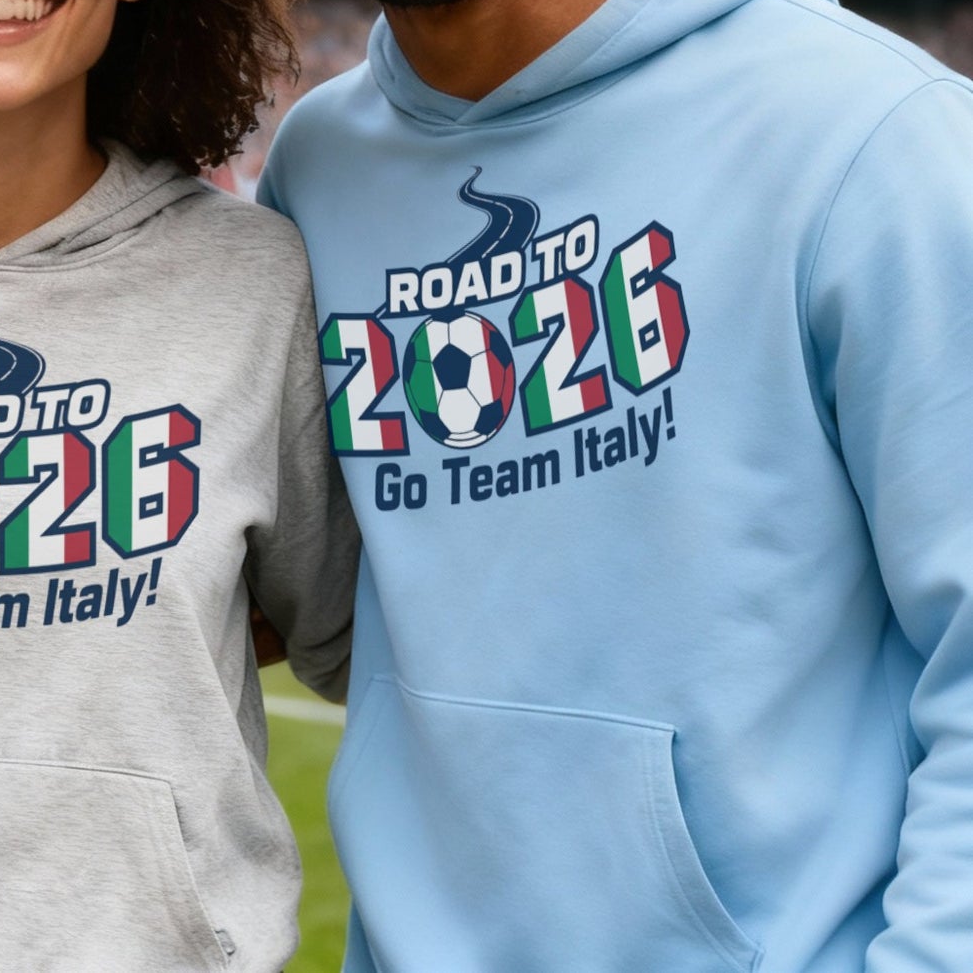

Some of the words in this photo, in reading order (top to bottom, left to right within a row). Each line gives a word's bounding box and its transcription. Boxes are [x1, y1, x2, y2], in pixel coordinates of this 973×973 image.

[386, 250, 526, 318] ROAD
[532, 213, 599, 282] TO
[318, 220, 691, 457] 2026
[30, 378, 112, 433] TO
[374, 462, 427, 511] Go
[442, 448, 561, 505] Team
[573, 387, 677, 478] Italy!
[43, 556, 163, 627] Italy!
